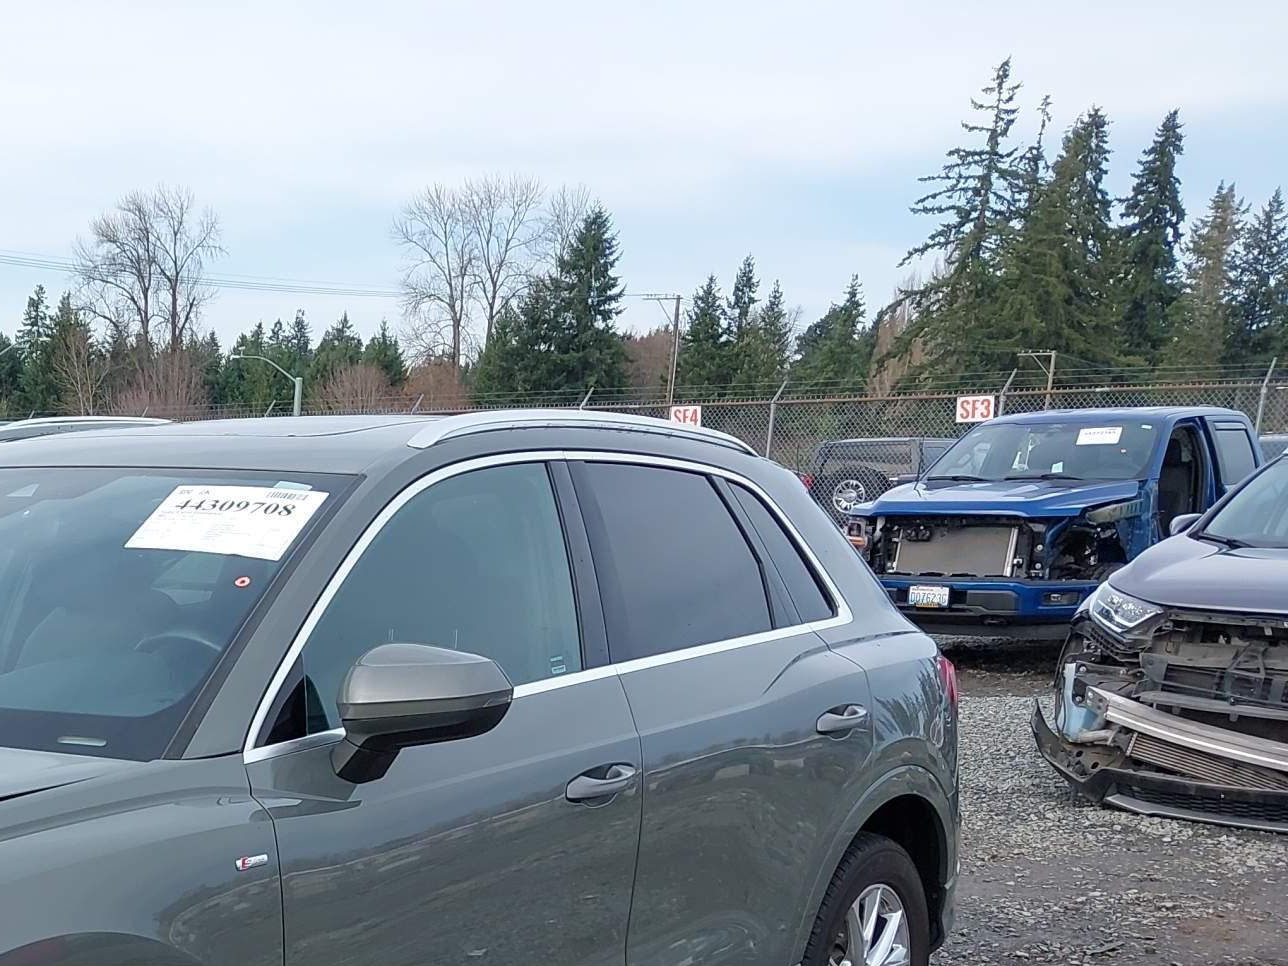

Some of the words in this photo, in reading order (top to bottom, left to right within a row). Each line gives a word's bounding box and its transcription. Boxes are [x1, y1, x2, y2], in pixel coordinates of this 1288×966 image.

[673, 407, 698, 425] SF4
[959, 398, 991, 419] SF3
[175, 498, 297, 517] 44309708
